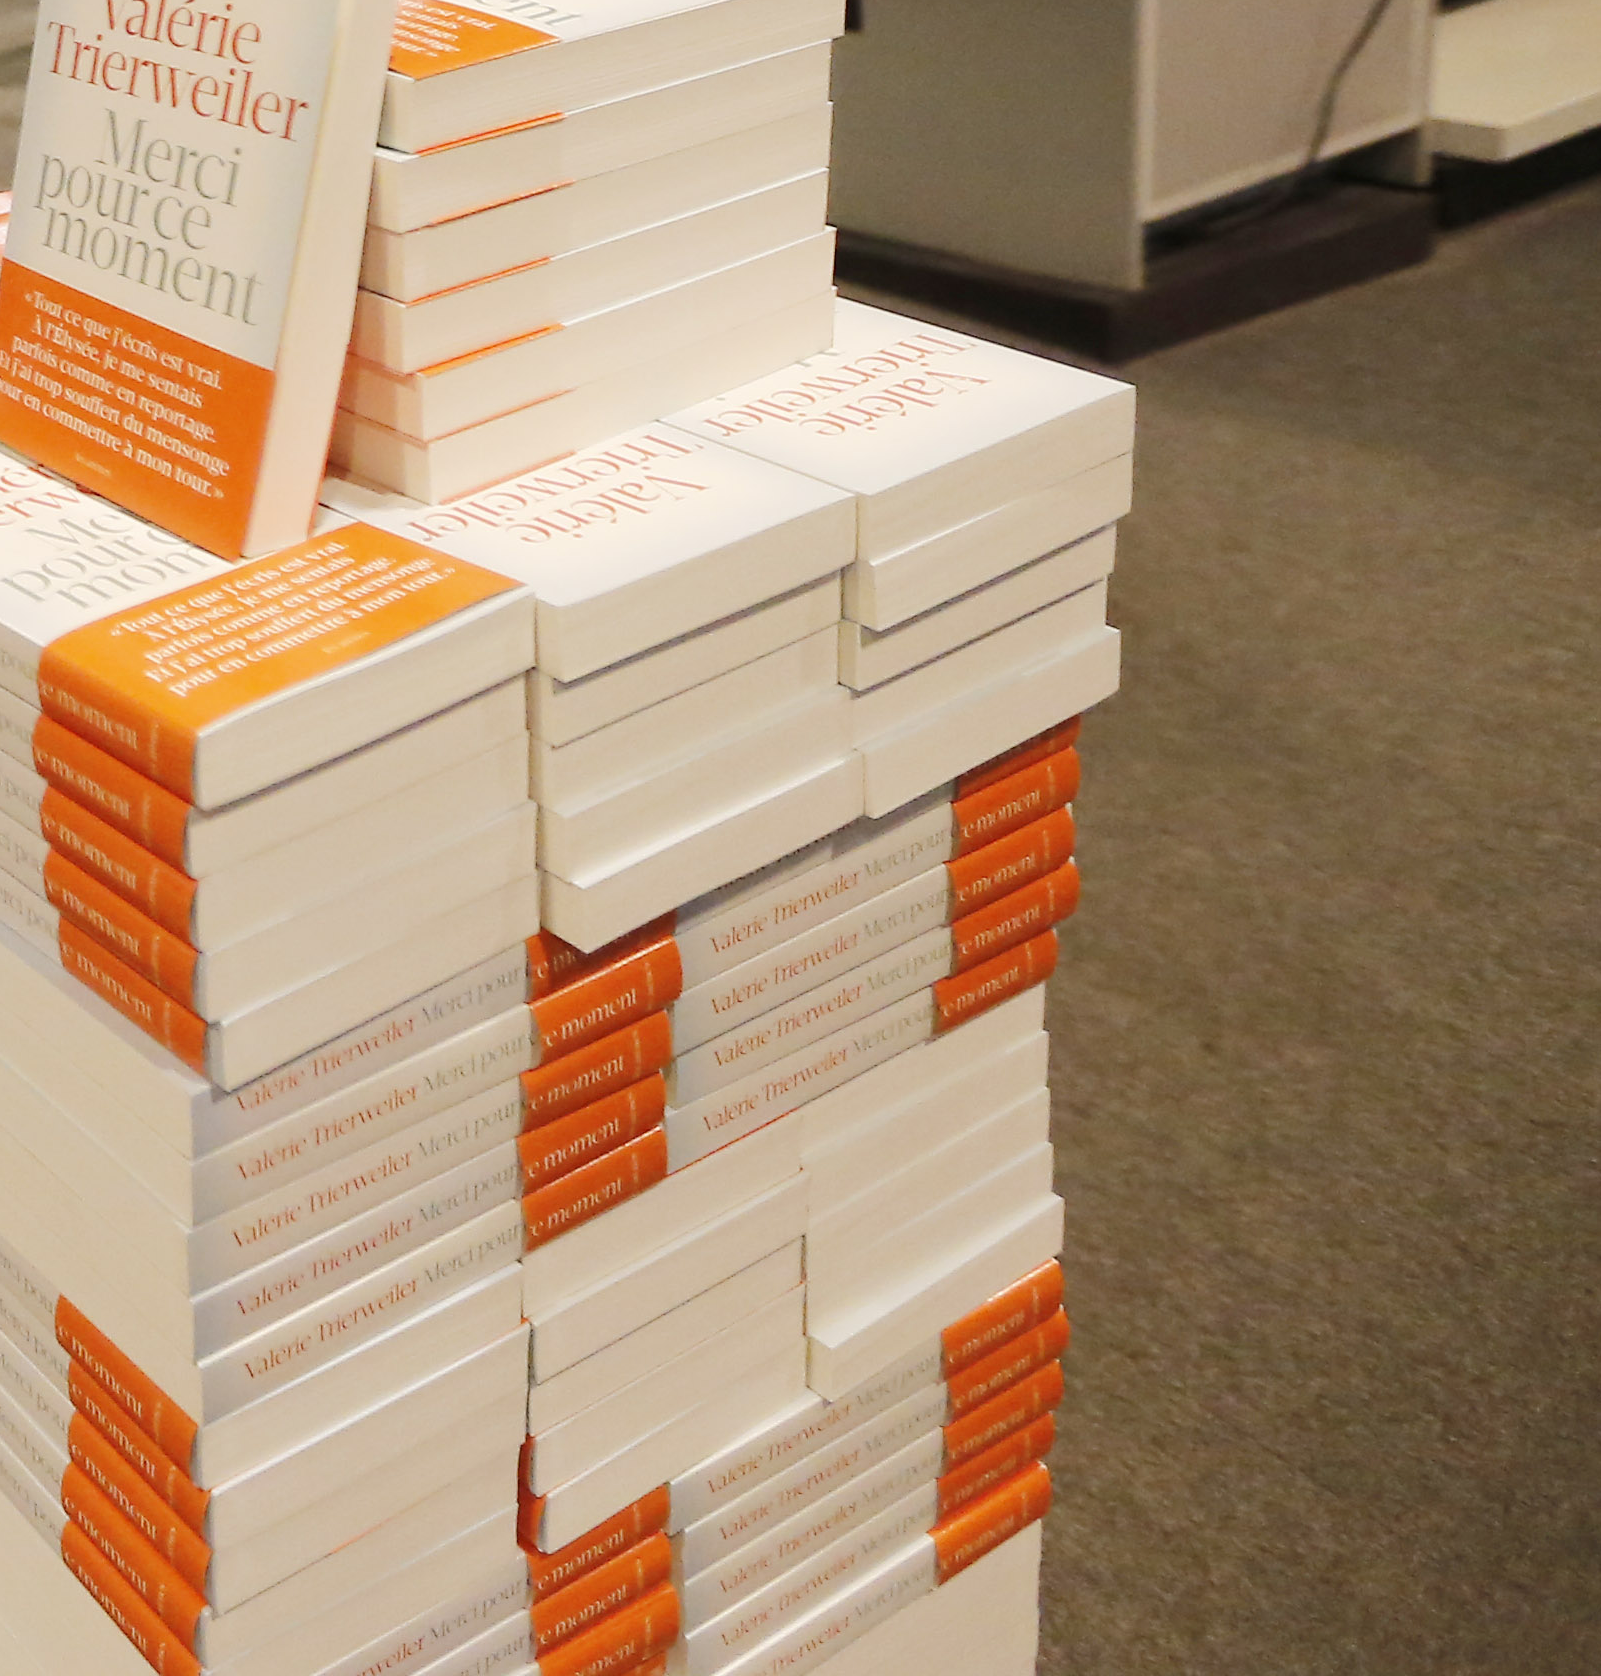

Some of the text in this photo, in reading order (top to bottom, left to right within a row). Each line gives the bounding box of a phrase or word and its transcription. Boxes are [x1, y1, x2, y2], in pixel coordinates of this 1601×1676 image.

[47, 20, 310, 142] Trierweiler
[94, 108, 243, 208] Merci
[35, 152, 213, 250] pour ce
[42, 207, 264, 327] moment
[12, 335, 58, 368] parfois
[59, 360, 115, 395] comme
[116, 386, 136, 405] en
[63, 310, 82, 327] ce
[83, 318, 111, 340] que
[160, 352, 184, 373] est
[104, 349, 118, 370] je
[121, 360, 146, 382] me
[148, 372, 203, 408] sentais
[23, 394, 42, 412] en
[42, 403, 122, 452] commettre
[136, 448, 173, 478] mon
[33, 372, 63, 399] trop
[64, 387, 121, 425] souffert
[123, 414, 144, 436] du
[145, 426, 230, 477] mensonge
[0, 532, 151, 604] pour
[164, 603, 190, 617] ce
[188, 590, 226, 610] que
[278, 556, 310, 574] est
[202, 637, 248, 659] trop
[245, 606, 321, 643] souffert
[317, 595, 347, 613] du
[343, 557, 436, 601] mensonge
[260, 581, 293, 599] me
[290, 556, 355, 586] sentais
[144, 632, 214, 665] parfois
[211, 603, 284, 637] comme
[282, 593, 311, 609] en
[168, 669, 218, 698] pour
[218, 657, 248, 673] en
[246, 614, 350, 663] commettre
[359, 588, 407, 613] mon
